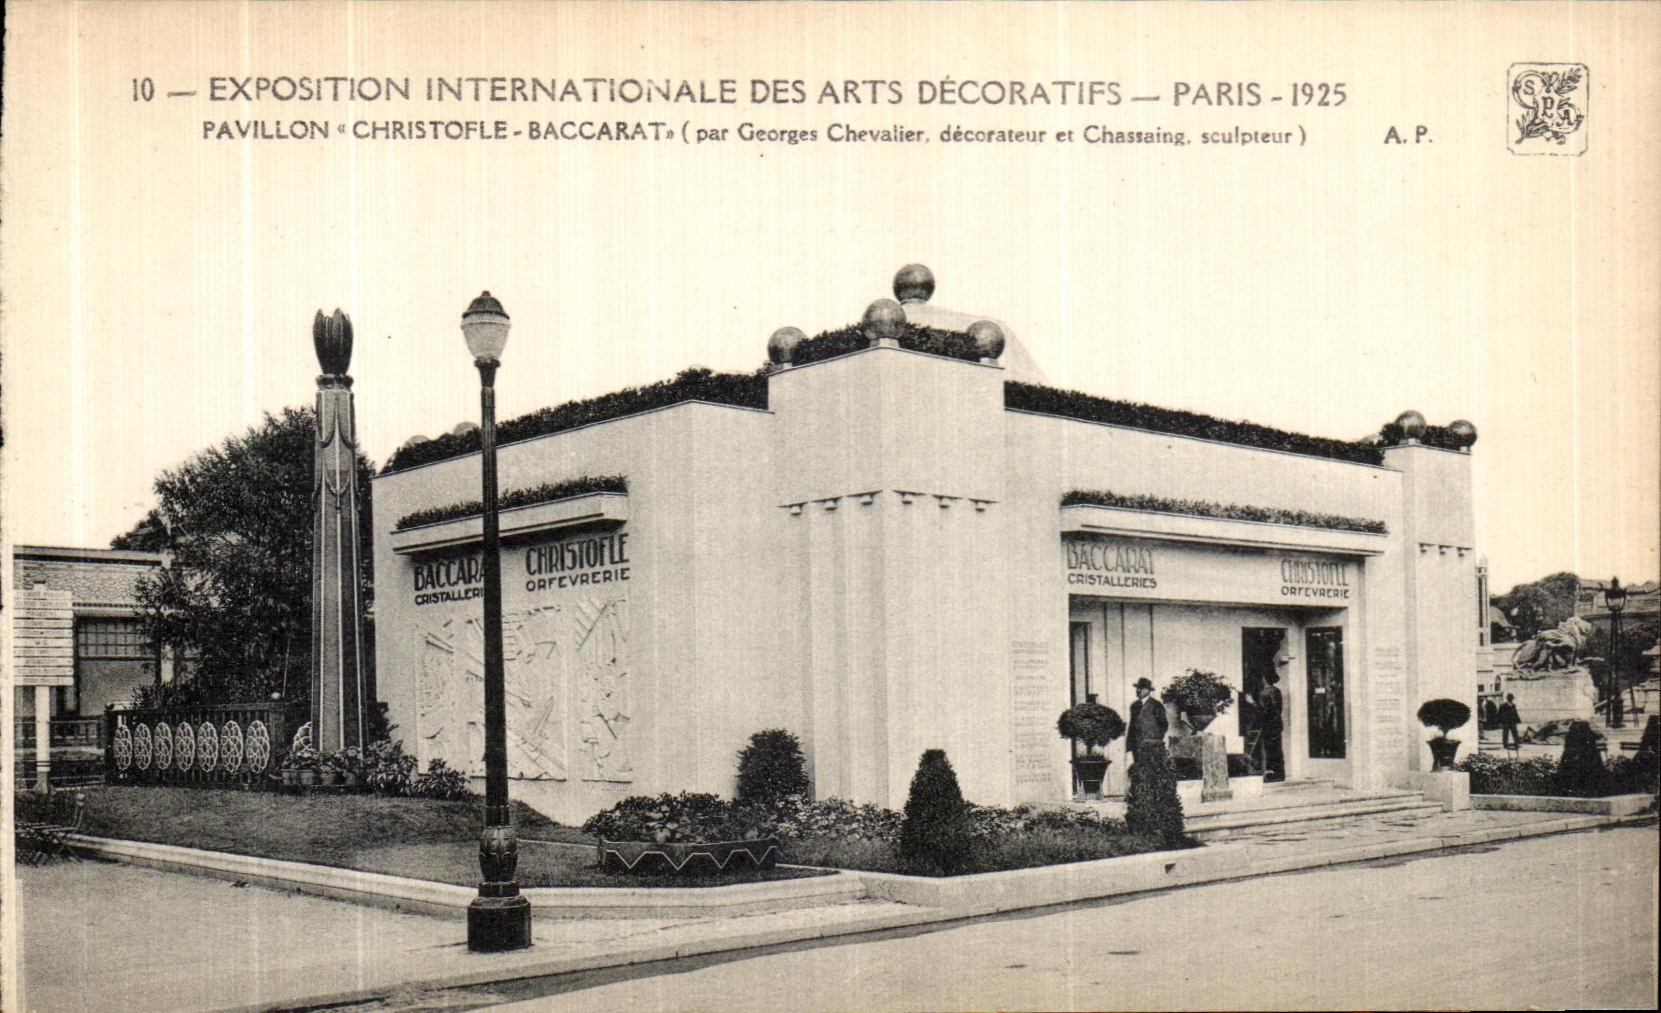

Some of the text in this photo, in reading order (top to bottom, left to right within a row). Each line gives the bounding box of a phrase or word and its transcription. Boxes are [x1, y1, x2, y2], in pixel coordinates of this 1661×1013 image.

[526, 533, 629, 575] CHRISTOFLE
[1066, 541, 1155, 575] BACCARAT
[414, 555, 487, 591] BACCARA
[526, 568, 630, 592] ORFEVRERIE
[1067, 573, 1158, 589] CRISTALLERIES
[414, 586, 485, 606] CRISTALLERI
[1280, 585, 1350, 600] ORFEVRERIE
